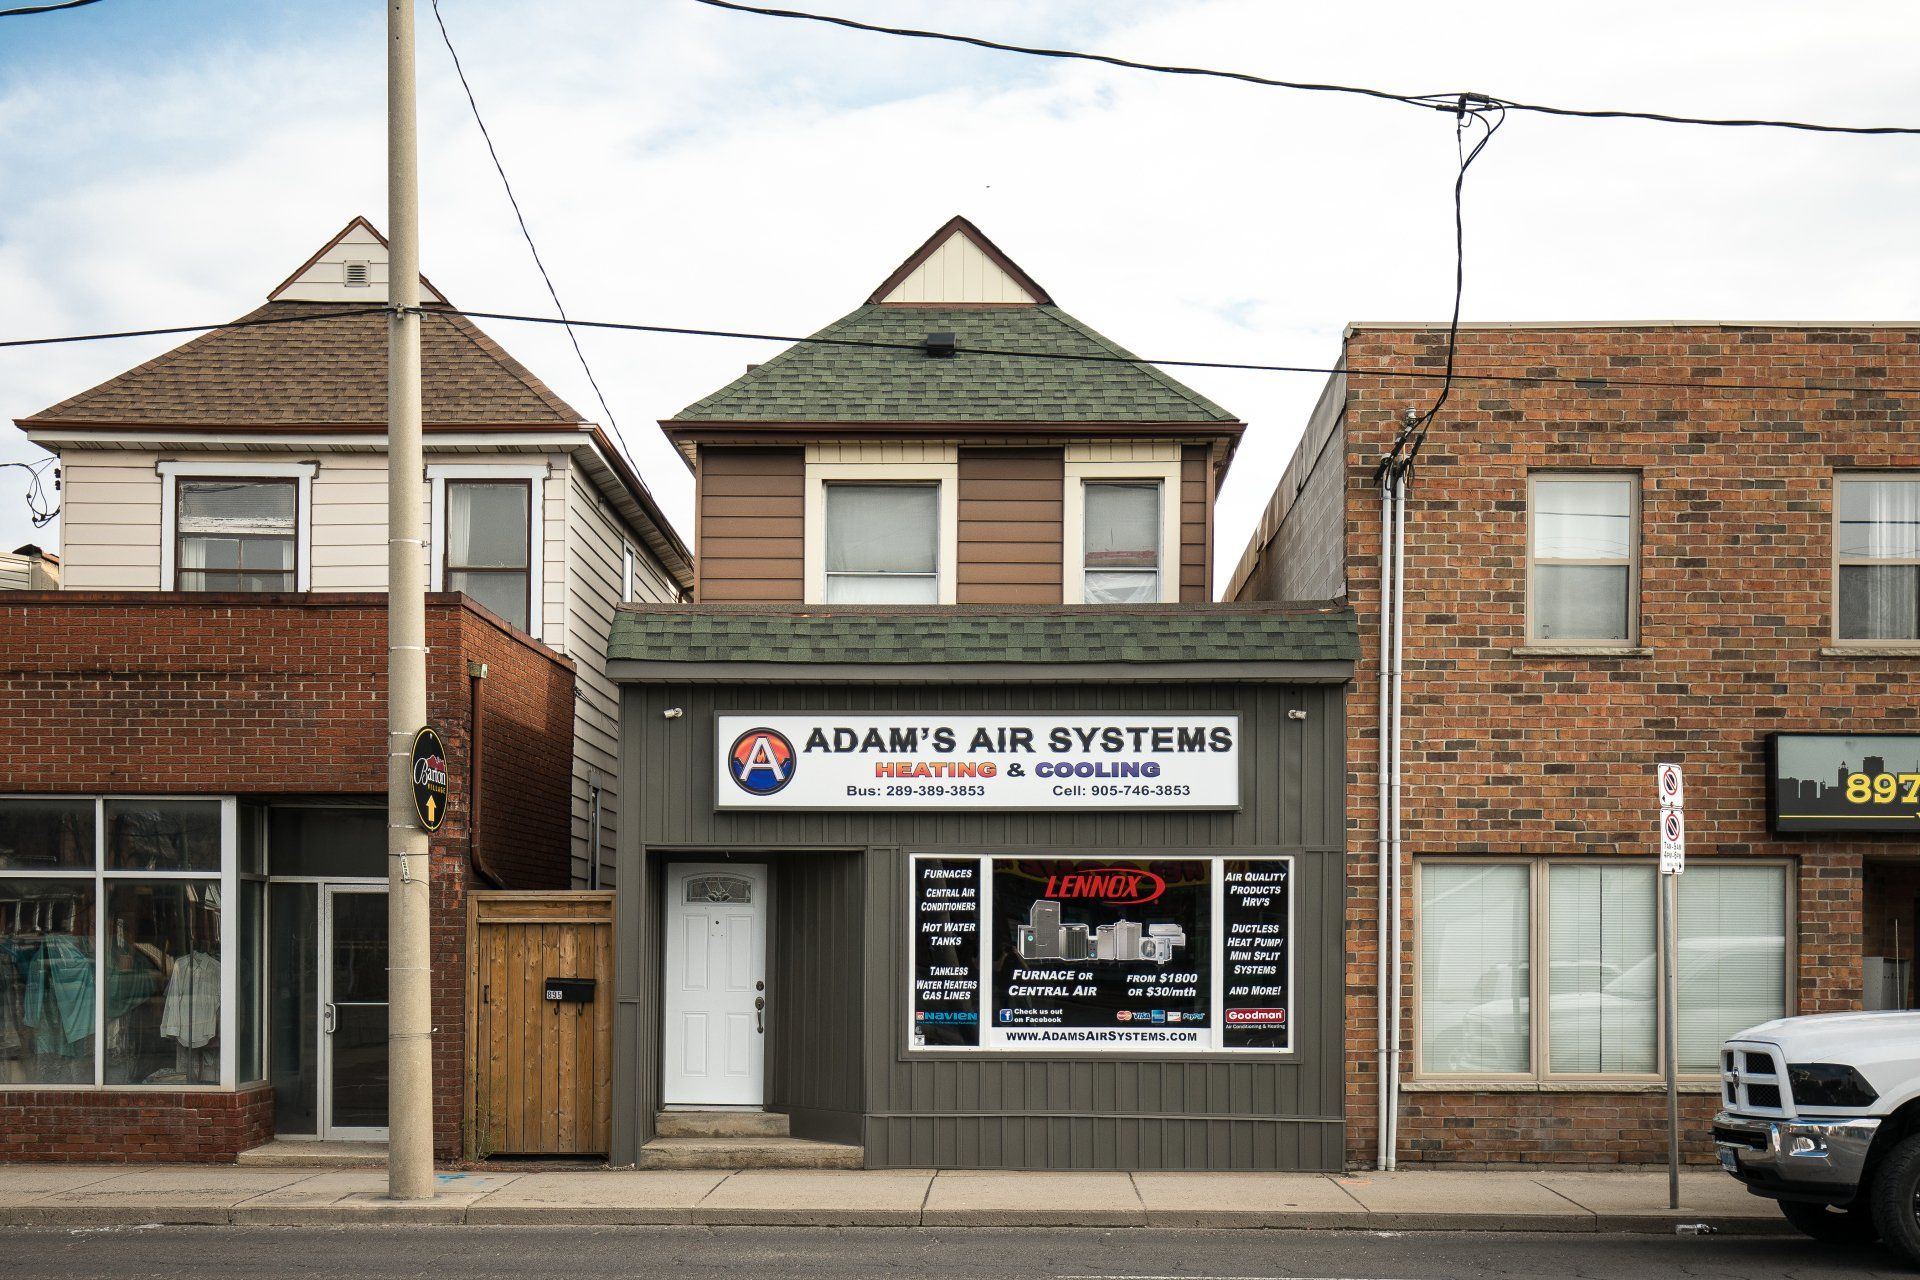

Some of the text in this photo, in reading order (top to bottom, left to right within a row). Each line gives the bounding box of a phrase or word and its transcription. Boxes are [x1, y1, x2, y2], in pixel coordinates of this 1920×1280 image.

[803, 727, 1233, 754] ADAM'S AIR SYSTEMS
[414, 757, 446, 786] Barton
[875, 761, 1161, 778] HEATING & COOLING
[846, 785, 985, 796] Bus: 289-389-3853
[1052, 785, 1191, 796] Cell: 905-746-3853
[1846, 773, 1920, 804] 897
[924, 869, 972, 878] FURNACES
[1225, 872, 1287, 882] AIR QUALITY
[1045, 875, 1142, 898] LENNOX
[1230, 885, 1281, 894] PRODUCTS
[926, 888, 975, 897] CENTRAL AIR
[921, 902, 976, 911] CONDITIONERS
[1242, 897, 1270, 906] HRV'S
[922, 923, 976, 932] HOT WATER
[1231, 924, 1279, 933] DUCTLESS
[931, 936, 962, 946] TANKS
[1227, 937, 1252, 946] HEAT
[1230, 951, 1281, 960] MINI SPLIT
[930, 966, 969, 976] TANKLESS
[1234, 965, 1276, 974] SYSTEMS
[1013, 969, 1093, 981] FURNACE OR
[1126, 973, 1198, 983] FROM $1800
[916, 980, 977, 990] WATER HEATERS
[922, 991, 971, 1000] GAS LINES
[1008, 985, 1097, 997] CENTRAL AIR
[1127, 986, 1196, 998] OR $30/mth
[1229, 986, 1282, 996] AND MORE!
[1024, 1015, 1062, 1023] Facebook
[1228, 1011, 1282, 1020] Goodman
